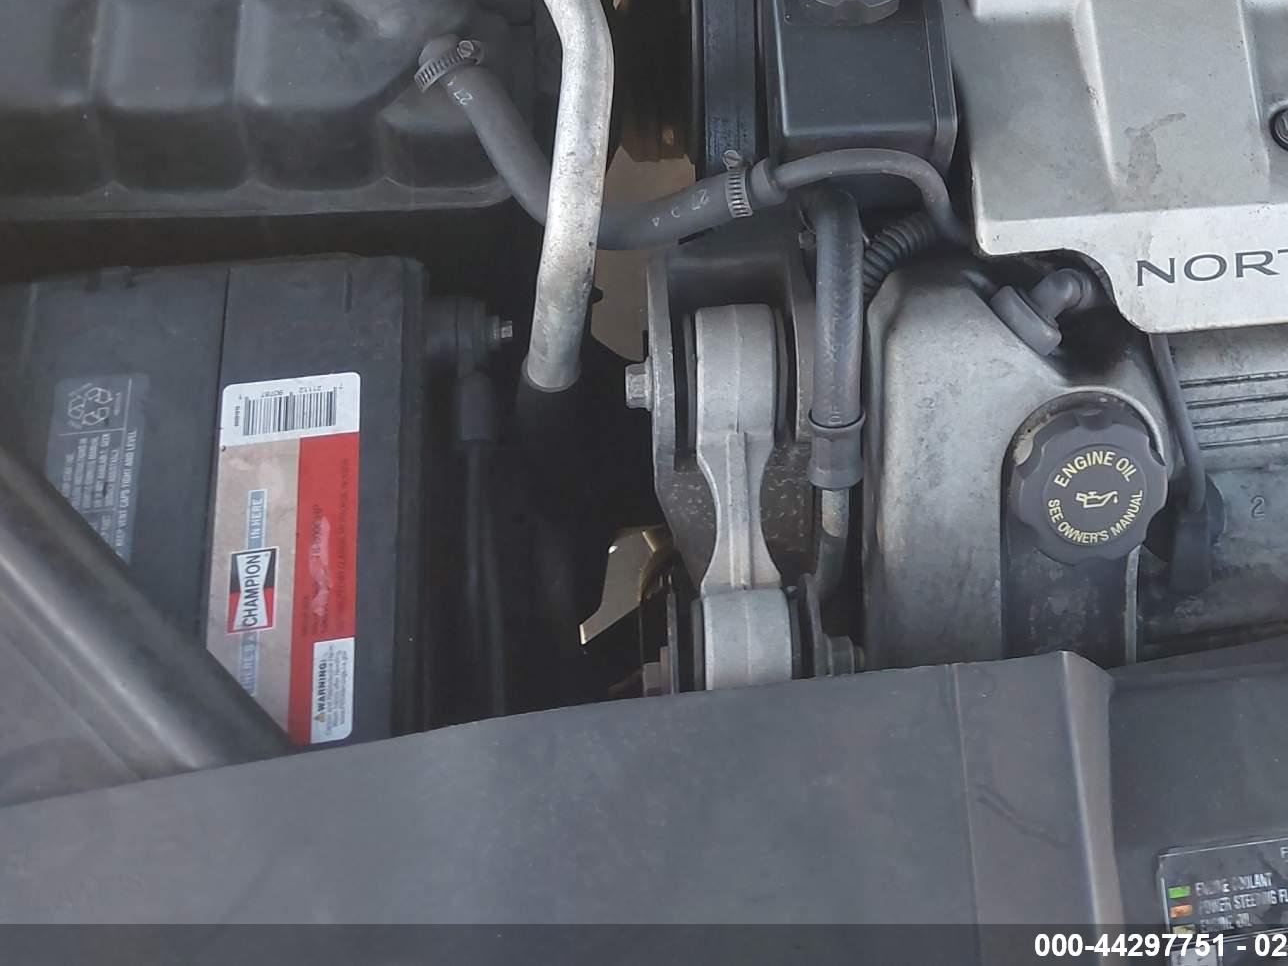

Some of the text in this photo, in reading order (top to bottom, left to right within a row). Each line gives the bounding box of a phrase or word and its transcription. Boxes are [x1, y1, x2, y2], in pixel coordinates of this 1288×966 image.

[126, 430, 137, 451] LEVEL
[124, 451, 135, 467] AND
[1054, 450, 1137, 488] ENGINE OIL
[121, 468, 133, 489] TIGHT
[120, 489, 131, 508] CAPS
[1251, 495, 1266, 519] 2
[118, 509, 128, 528] VENT
[251, 497, 263, 525] HERE
[1048, 489, 1144, 544] SEE OWNER'S MANUAL
[251, 525, 261, 540] IN
[242, 553, 261, 628] CHAMPION
[317, 658, 328, 712] WARNING!
